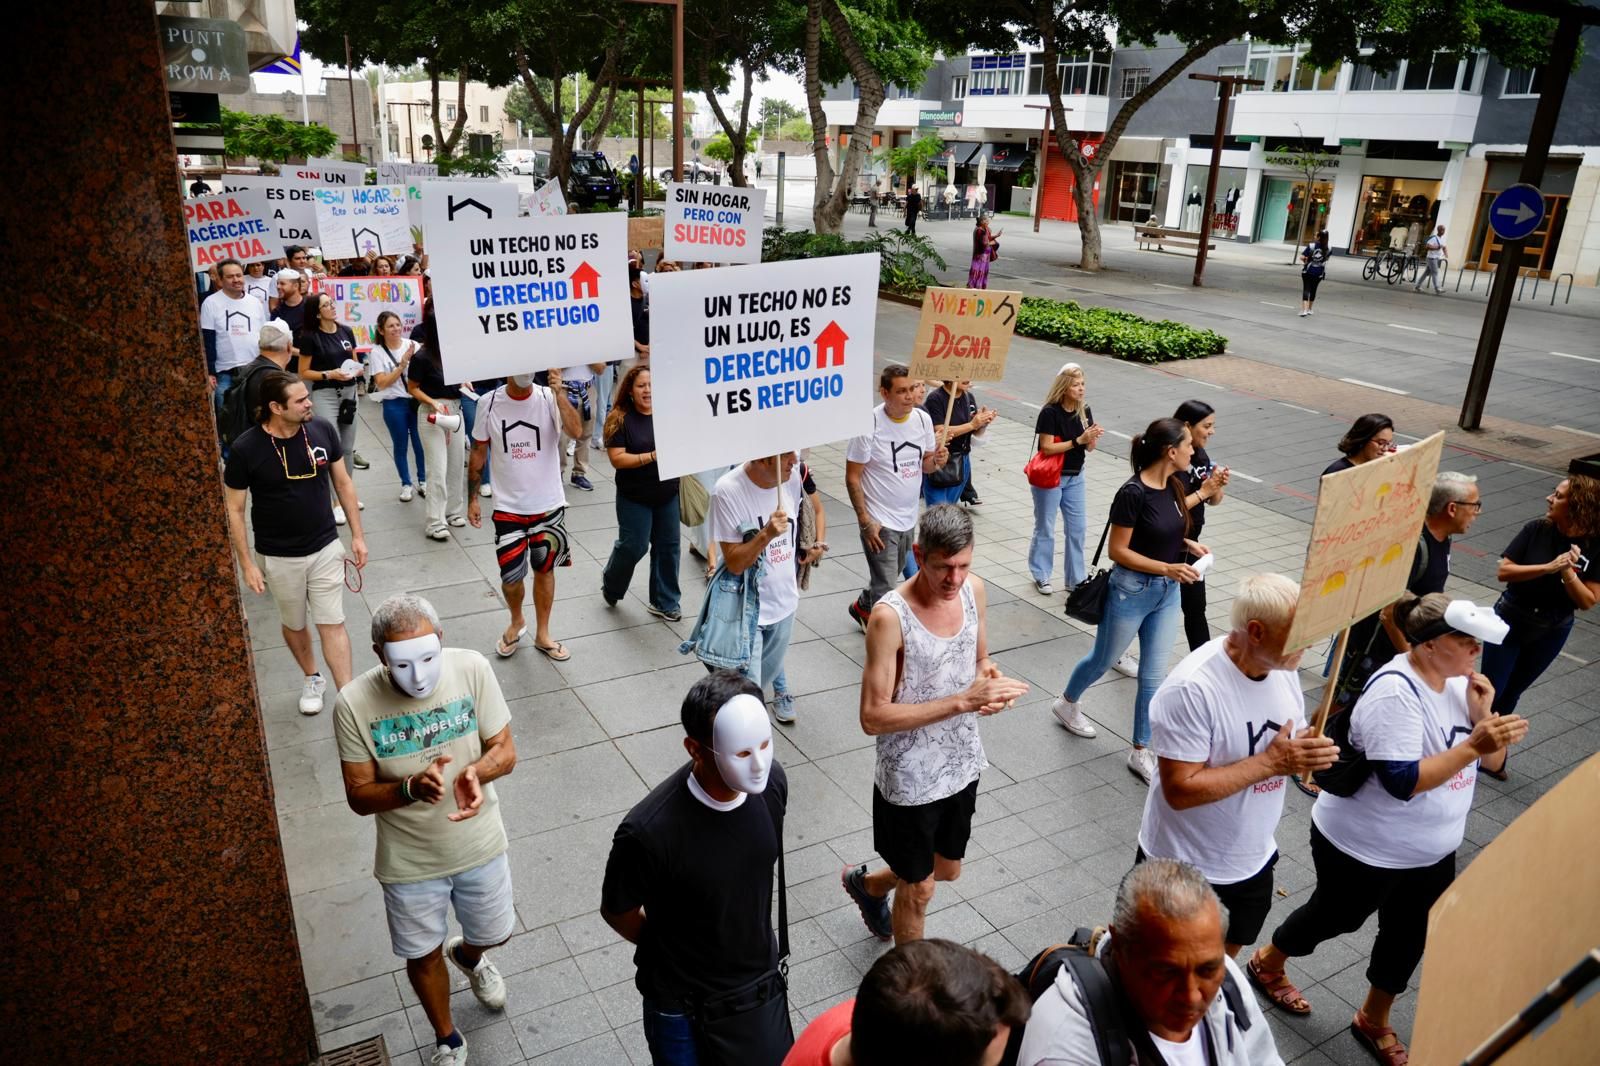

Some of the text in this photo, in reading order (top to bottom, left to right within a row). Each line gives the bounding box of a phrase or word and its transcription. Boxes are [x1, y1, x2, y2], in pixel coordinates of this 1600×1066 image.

[168, 28, 224, 46] PUNT
[168, 64, 231, 81] ROMA
[920, 111, 954, 120] Blancodent
[325, 173, 346, 184] UN
[266, 188, 285, 200] ES
[676, 188, 751, 212] SIN HOGAR,
[183, 198, 250, 224] PARA.
[683, 208, 742, 224] PERO CON
[189, 219, 270, 243] ACÉRCATE.
[674, 223, 746, 247] SUEÑOS
[197, 237, 271, 266] ACTÚA.
[470, 233, 599, 255] UN TECHO NO ES
[472, 257, 565, 279] UN LUJO, ES
[475, 280, 568, 308] DERECHO
[704, 285, 851, 318] UN TECHO NO ES
[478, 303, 600, 334] Y ES REFUGIO
[704, 317, 811, 348] UN LUJO, ES
[704, 345, 811, 384] DERECHO
[706, 373, 843, 417] Y ES REFUGIO
[769, 539, 787, 549] NADIE
[770, 549, 781, 557] SIN
[382, 713, 469, 746] LOS ANGELES
